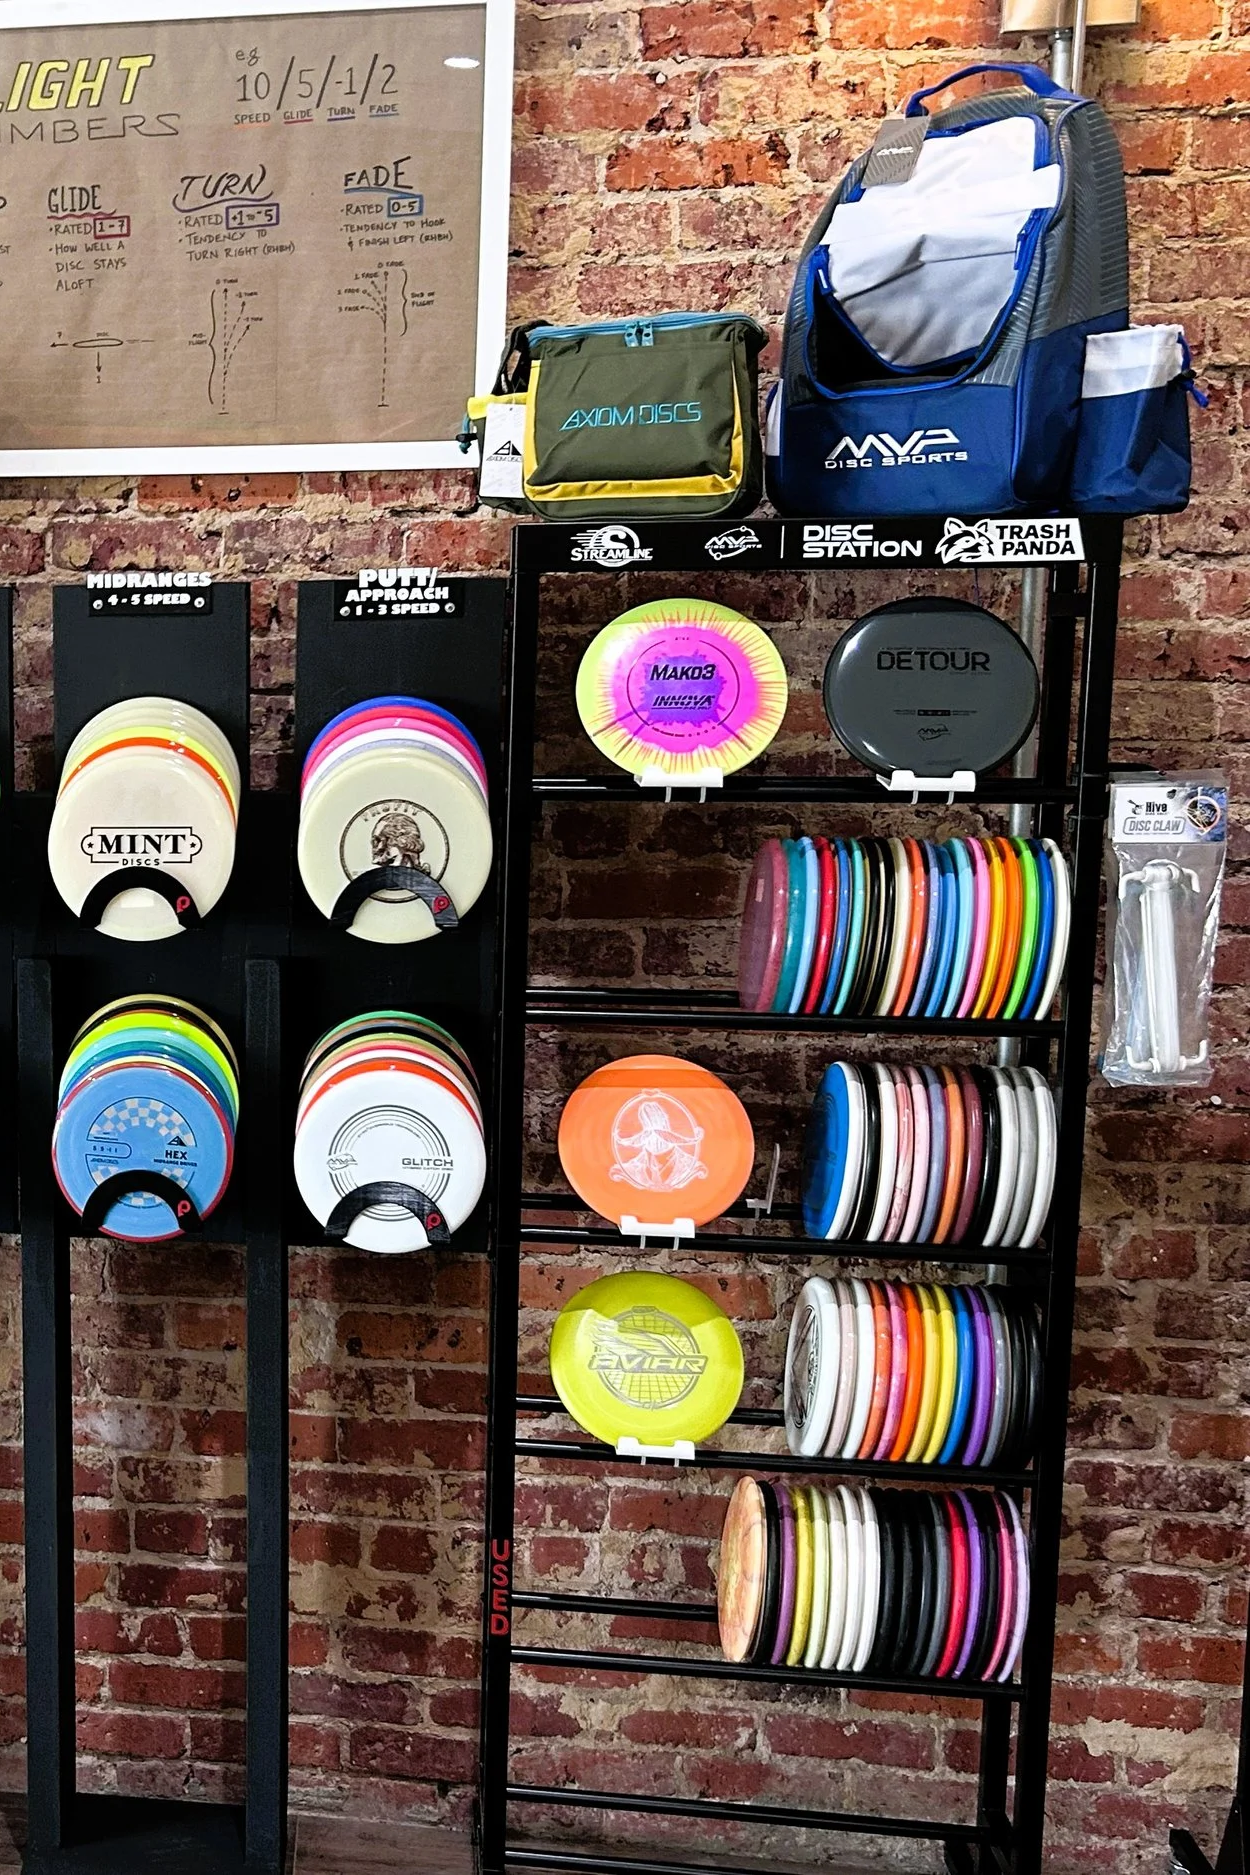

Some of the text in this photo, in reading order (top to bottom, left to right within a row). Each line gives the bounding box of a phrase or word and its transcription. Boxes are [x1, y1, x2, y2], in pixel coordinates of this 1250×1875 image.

[234, 103, 398, 125] SPEED GLIDE TURN FADE
[343, 156, 413, 189] FADE
[180, 164, 266, 200] TURN
[48, 184, 102, 214] GLIDE
[345, 203, 384, 216] RATED
[184, 214, 223, 228] RATED
[343, 221, 397, 233] TENDENCY
[403, 220, 415, 228] TO
[54, 223, 92, 235] RATED
[185, 229, 267, 246] TENDENCY TO
[358, 237, 390, 247] FINISH
[393, 235, 415, 244] LEFT
[84, 242, 112, 252] WELL
[117, 240, 125, 250] A
[186, 250, 218, 261] TURN
[224, 246, 259, 258] RIGHT
[56, 257, 127, 272] DISC STAYS
[56, 278, 94, 291] ALOFT
[559, 402, 700, 431] AXIOM DISCS
[826, 428, 960, 460] MVP
[824, 451, 968, 469] DISC SPORTS
[803, 524, 874, 542] DISC
[995, 524, 1071, 540] TRASH
[705, 535, 759, 546] MVP
[1001, 540, 1076, 556] PANDA
[570, 548, 653, 562] STREAMLINE
[803, 540, 922, 558] STATION
[86, 571, 212, 590] MIDRANGES
[358, 567, 438, 588] PUTT/
[107, 593, 191, 606] 4 5 SPEED
[344, 587, 449, 602] APPROACH
[355, 602, 440, 616] 1 3 SPEED
[877, 651, 990, 671] DETOUR
[650, 664, 716, 680] MAKO3
[652, 695, 715, 706] INNOVA
[1145, 801, 1168, 812] Hive
[1129, 820, 1181, 831] DISC CLAW
[98, 834, 186, 855] MINT
[121, 857, 161, 867] DISCS
[165, 1149, 188, 1160] HEX
[401, 1157, 453, 1167] GLITCH
[591, 1354, 706, 1373] AVIAR
[490, 1538, 510, 1636] USED
